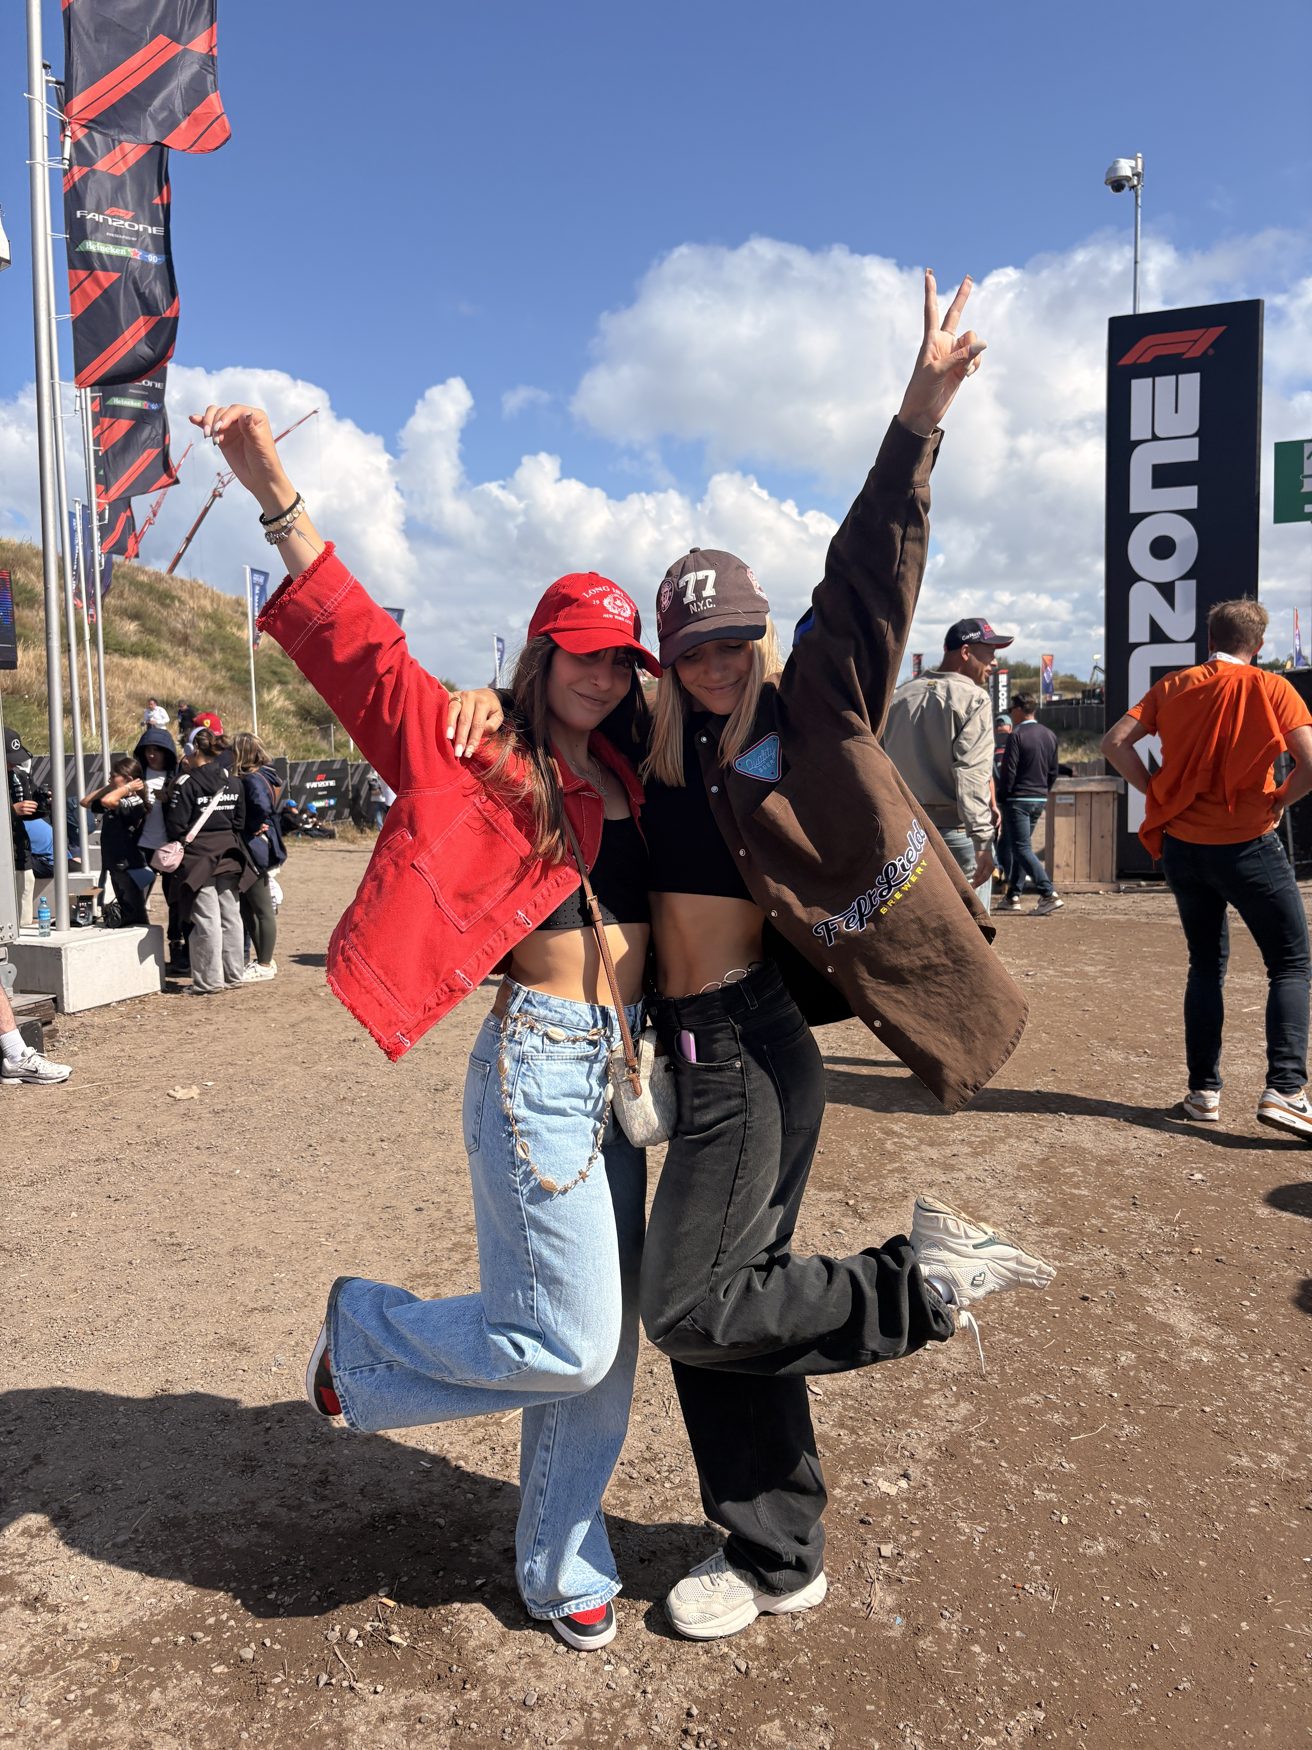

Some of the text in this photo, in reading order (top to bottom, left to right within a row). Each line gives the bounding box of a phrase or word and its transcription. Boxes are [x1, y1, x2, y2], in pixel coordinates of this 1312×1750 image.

[76, 210, 165, 236] FANZONE
[85, 241, 127, 256] Heineken
[581, 585, 611, 599] LONG
[678, 569, 716, 605] 77
[689, 598, 716, 614] N.Y.C.
[1127, 372, 1201, 834] NZONE
[879, 859, 928, 915] BREWERY
